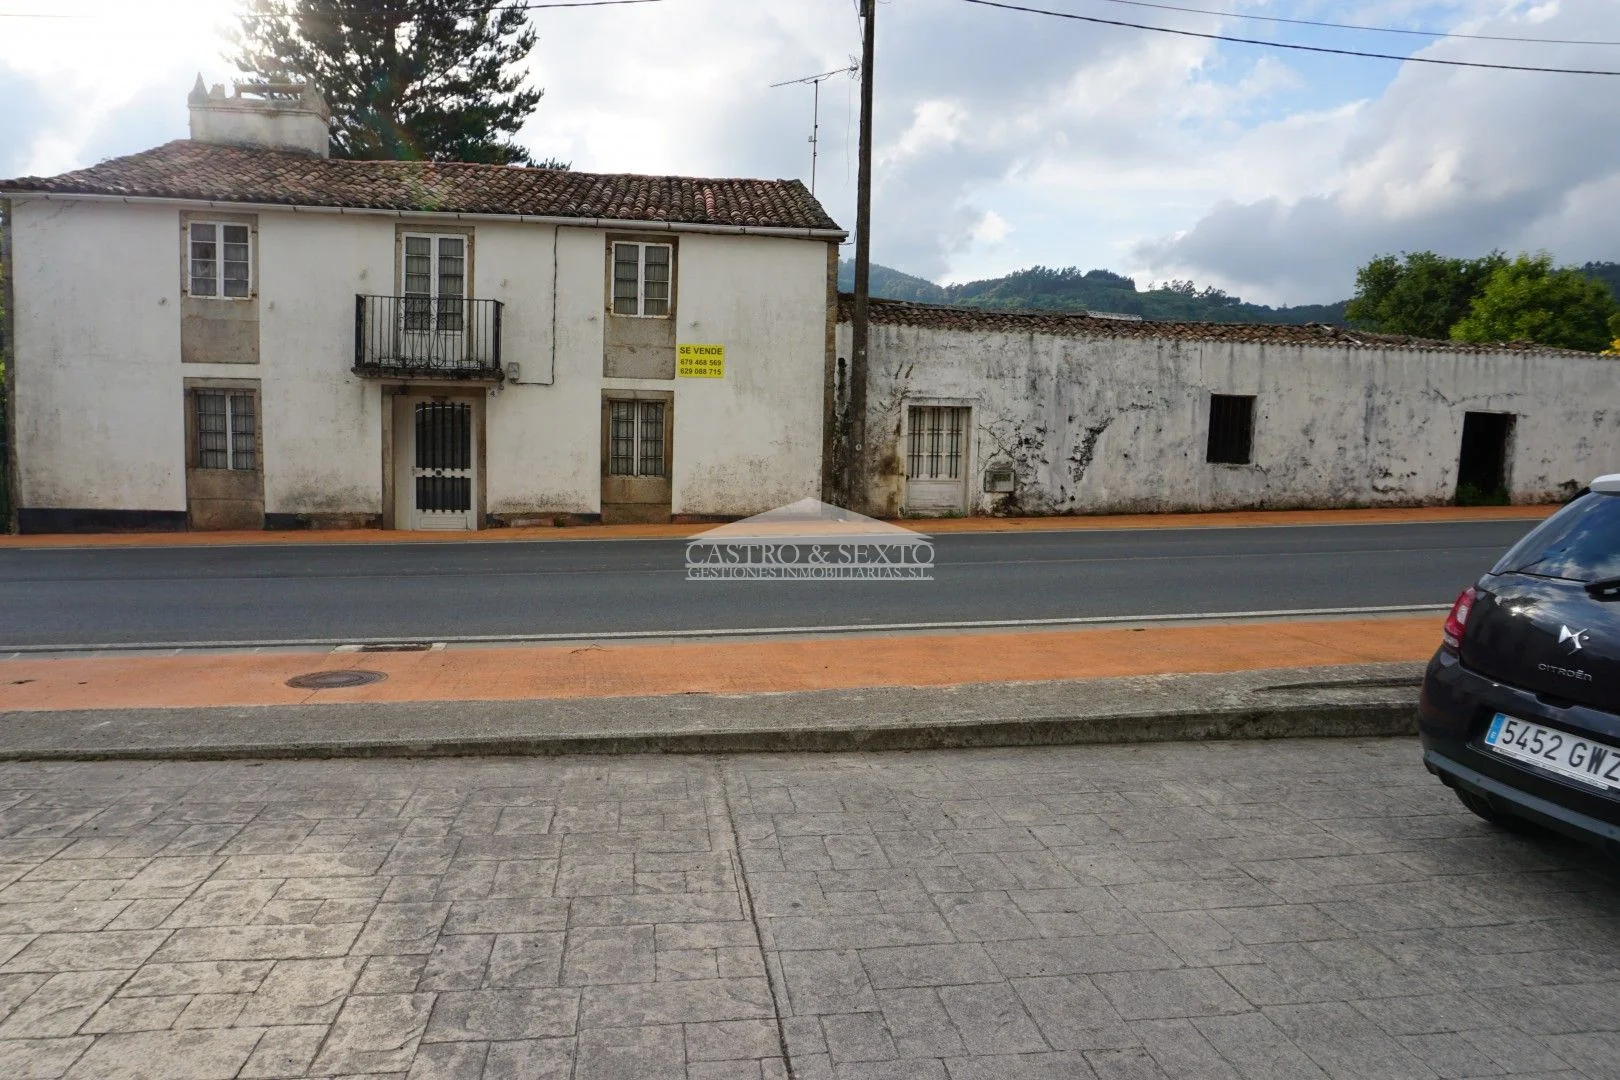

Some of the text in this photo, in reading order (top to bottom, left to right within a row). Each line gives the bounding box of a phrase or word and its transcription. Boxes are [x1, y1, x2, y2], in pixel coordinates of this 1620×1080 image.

[680, 346, 723, 355] SE VENDE
[680, 358, 693, 366] 679
[680, 367, 693, 375] 629
[709, 368, 722, 376] 715
[1502, 720, 1563, 761] 5452
[1568, 742, 1620, 782] GWZ
